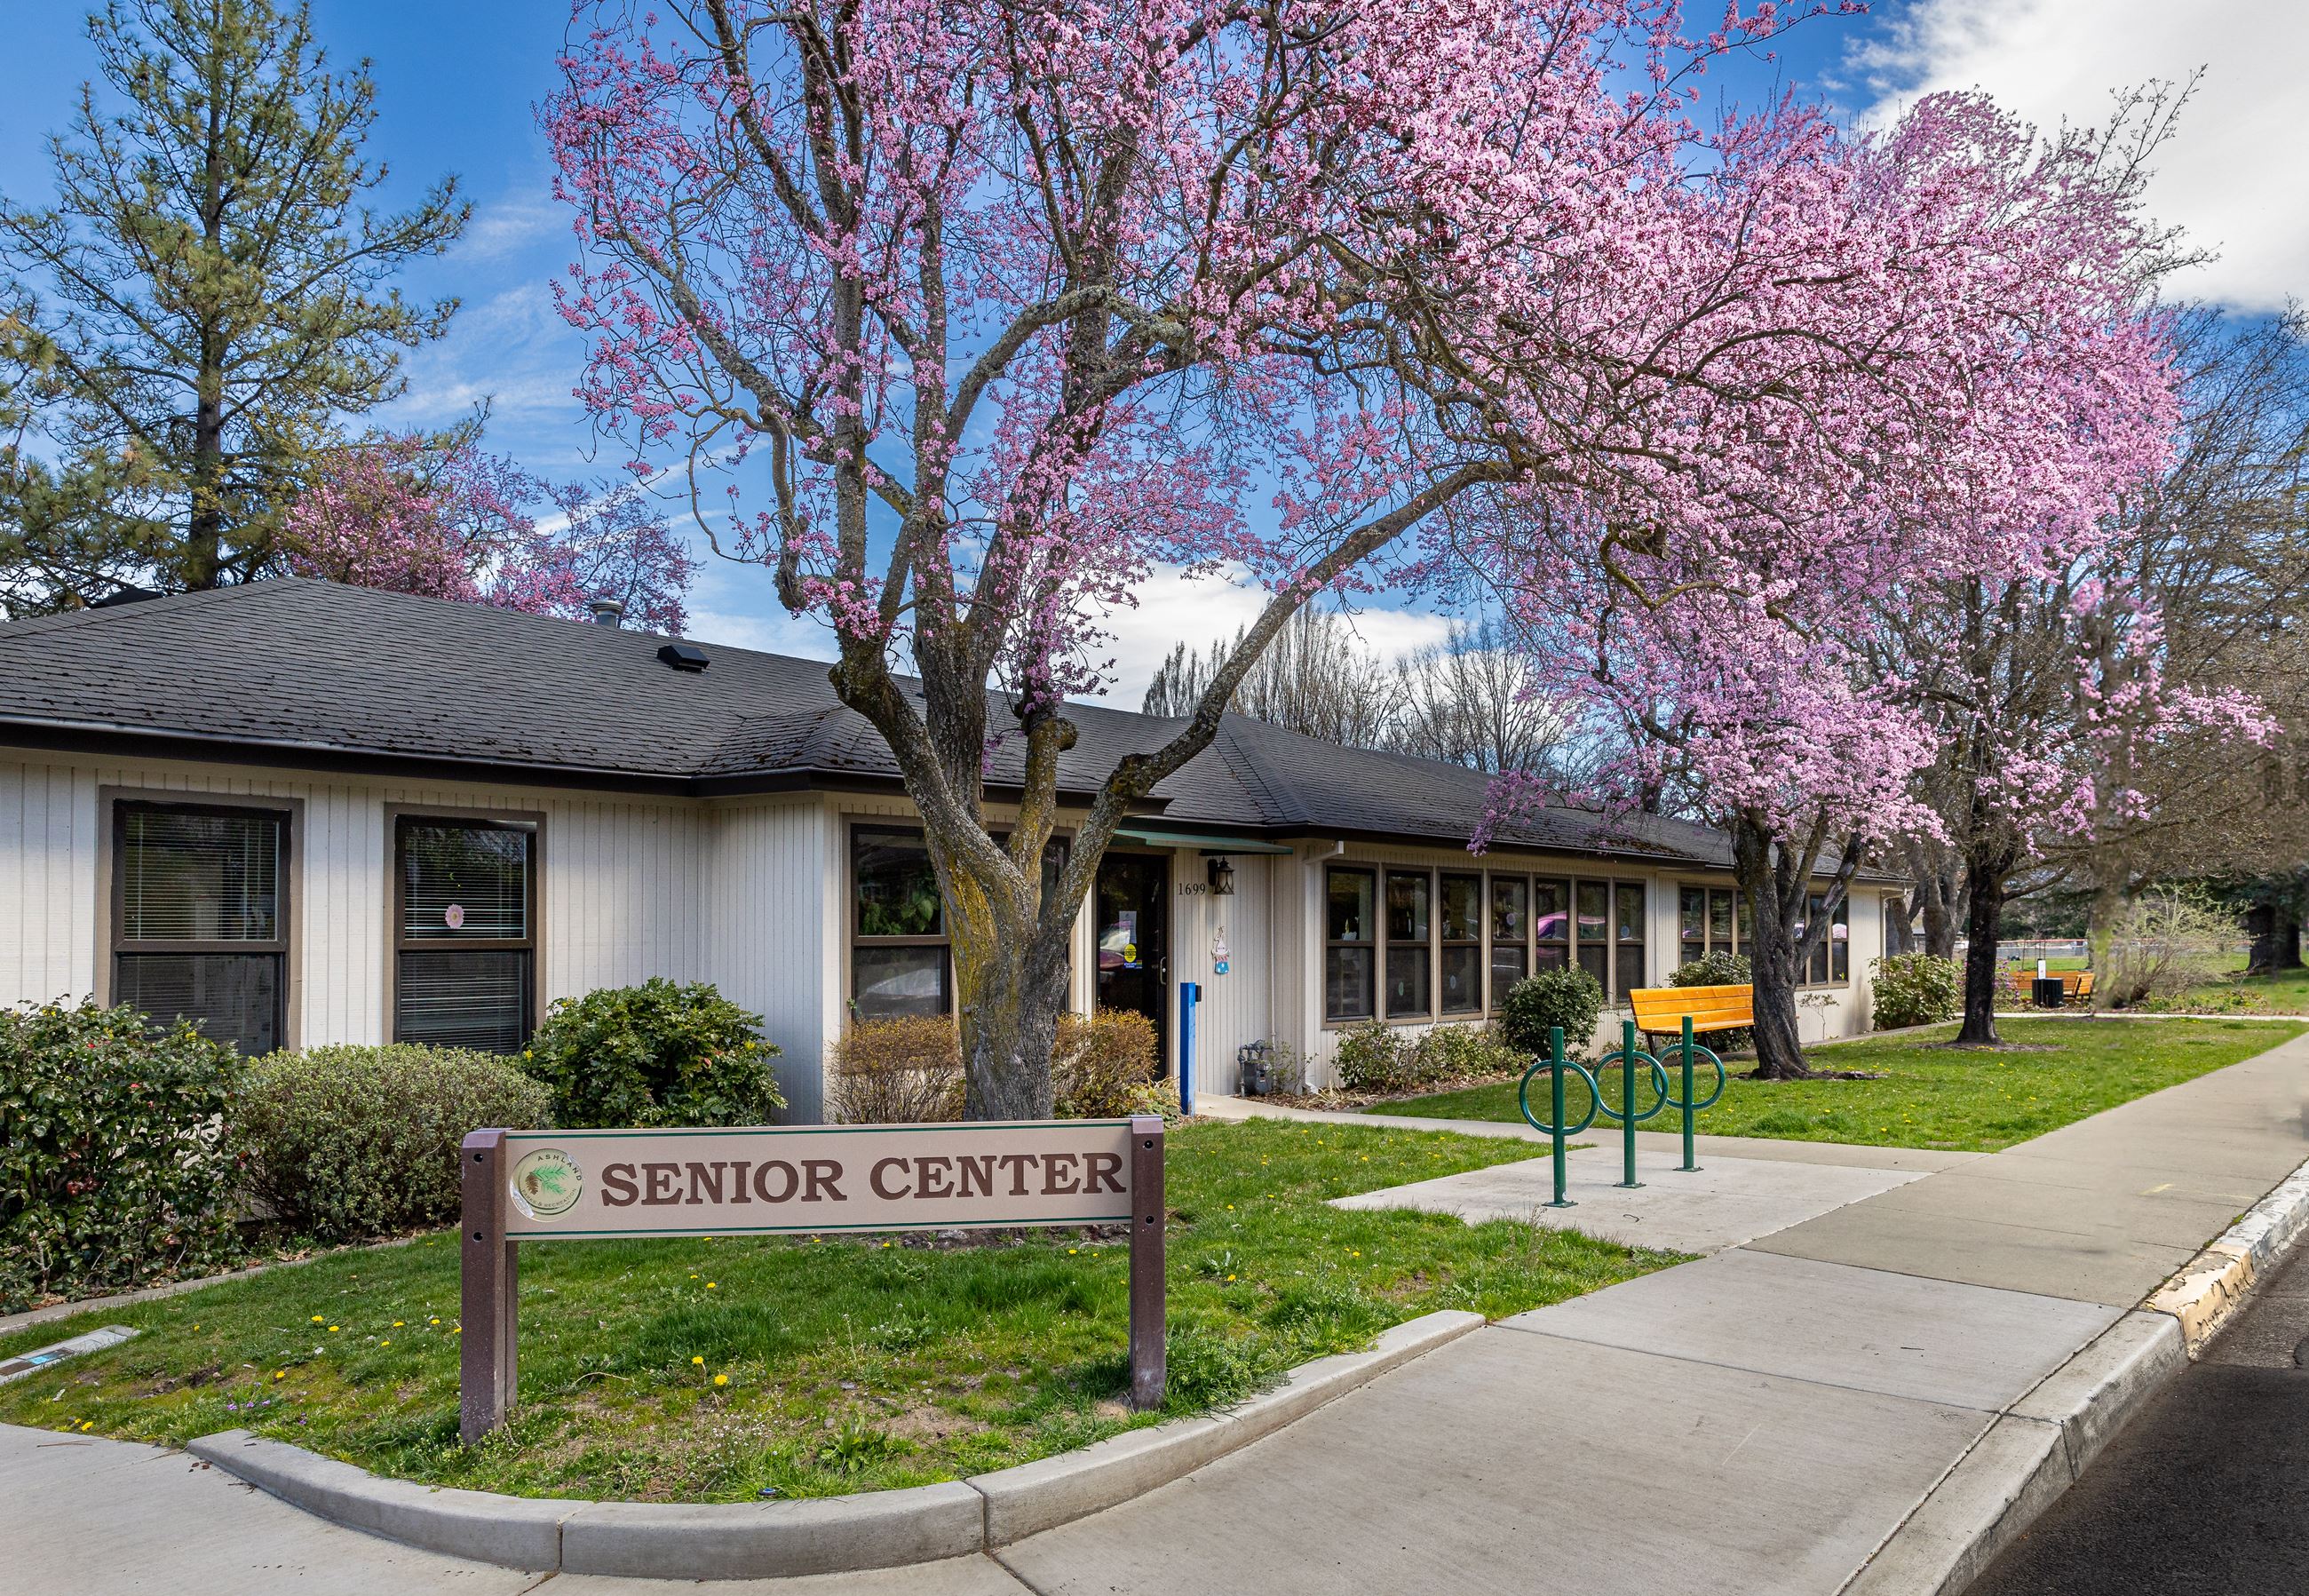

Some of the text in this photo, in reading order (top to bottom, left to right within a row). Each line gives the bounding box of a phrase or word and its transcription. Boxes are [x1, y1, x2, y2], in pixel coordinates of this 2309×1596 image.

[1178, 883, 1205, 895] 1699
[537, 1155, 583, 1181] ASHLAND
[601, 1152, 1128, 1206] SENIOR CENTER
[544, 1188, 576, 1207] RECREATION
